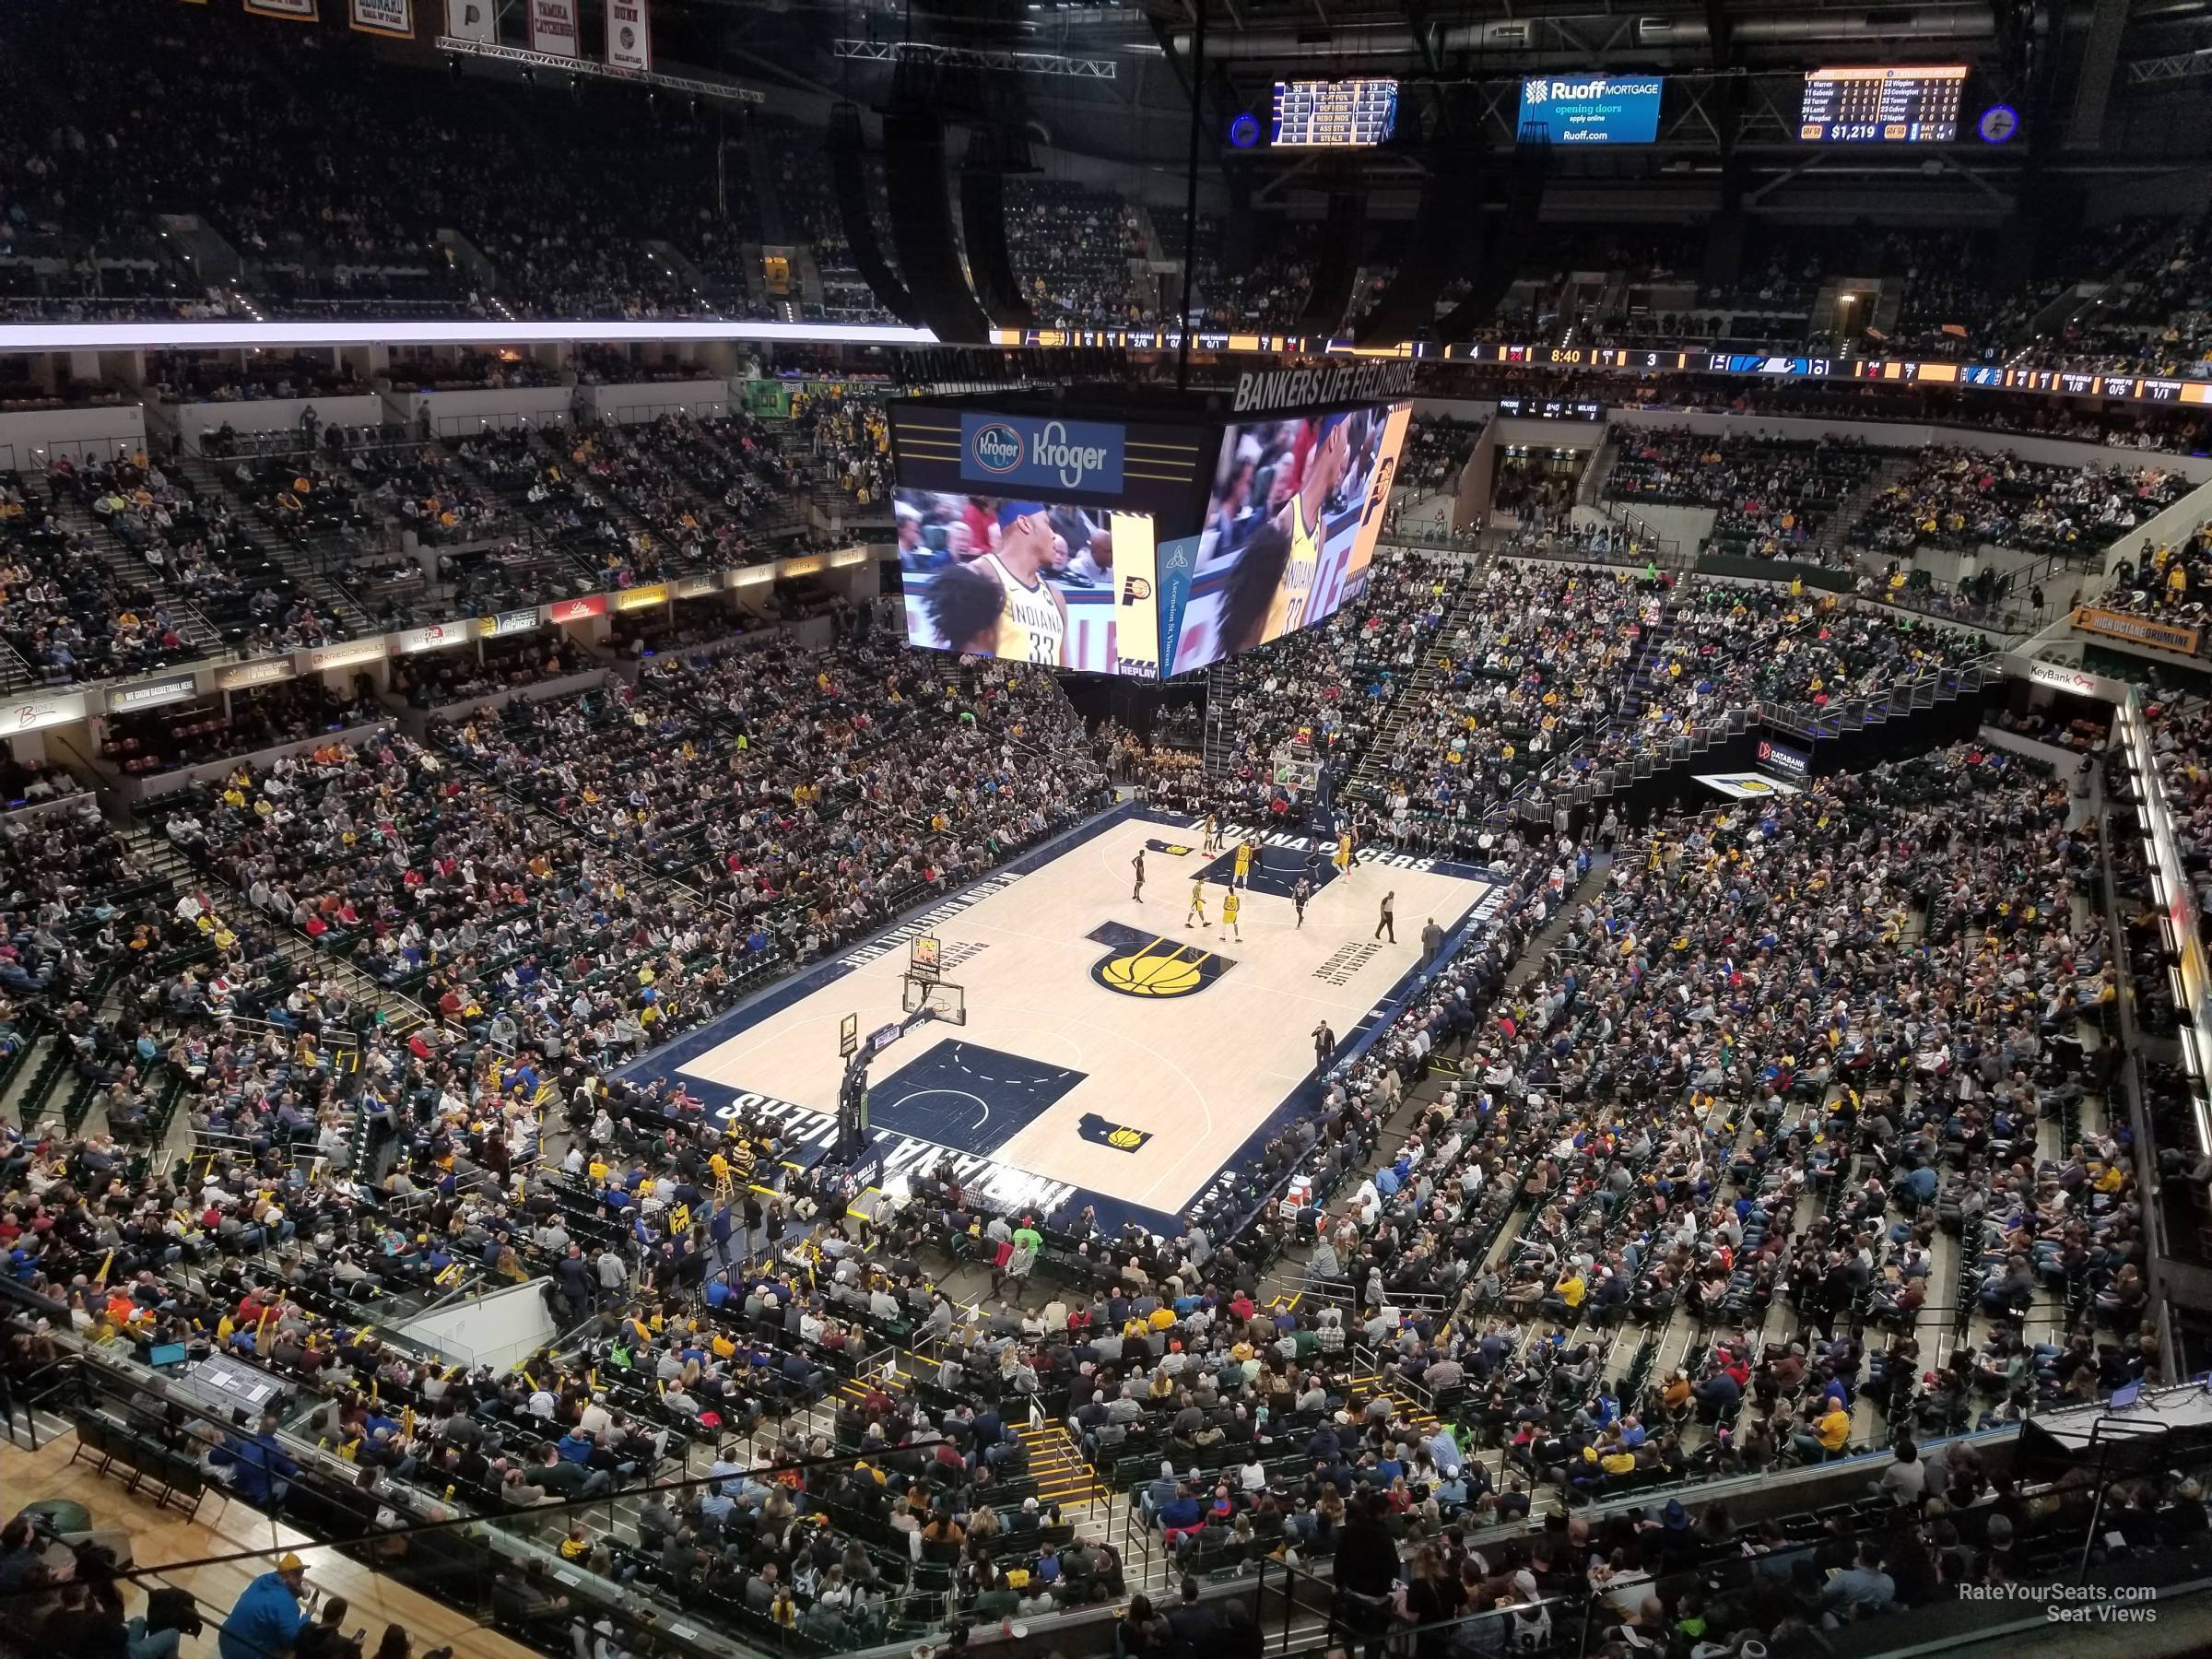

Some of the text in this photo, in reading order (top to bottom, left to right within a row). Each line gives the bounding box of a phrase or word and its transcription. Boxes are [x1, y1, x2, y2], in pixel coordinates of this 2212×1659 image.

[538, 2, 568, 20] TAMIKA
[615, 6, 638, 22] DUNN
[1551, 81, 1658, 99] Ruoff MORTGAGE
[1556, 103, 1622, 115] opening doors
[1570, 115, 1586, 124] apply
[1563, 130, 1607, 140] Ruoff.com
[1831, 124, 1875, 140] $1,219
[1135, 339, 1147, 347] 2/6
[1206, 340, 1219, 348] 0/1
[1469, 346, 1479, 359] 4
[1511, 352, 1522, 360] 24
[1551, 349, 1580, 362] 8:40
[1605, 356, 1609, 365] 1
[1647, 354, 1656, 366] 3
[1869, 369, 1877, 377] 2
[1906, 370, 1913, 379] 7
[1234, 361, 1418, 411] BANKERS LIFE FIELDHOUSE
[2018, 377, 2024, 386] 4
[2041, 379, 2046, 389] 1
[2068, 382, 2083, 392] 1/8
[2109, 385, 2125, 395] 0/5
[2154, 388, 2169, 399] 1/1
[980, 431, 1019, 465] Kroger
[1032, 421, 1107, 488] Kroger
[1340, 577, 1365, 604] REPLAY
[571, 601, 590, 614] Lilly
[1169, 579, 1180, 622] Ascension
[502, 617, 536, 630] @Pacers
[1010, 603, 1064, 634] INDIANA
[424, 629, 439, 637] the
[2094, 616, 2190, 647] HIGH OCTANE DRUMLINE
[427, 636, 444, 645] fan
[1030, 632, 1054, 664] 33
[1164, 634, 1173, 667] Vincent
[1120, 665, 1156, 678] REPLAY
[2030, 665, 2071, 684] KeyBank
[125, 680, 194, 700] WE GROW BASKETBALL HERE
[1297, 733, 1309, 743] 24
[1771, 750, 1806, 769] DATABANK
[956, 877, 1002, 905] GROW
[875, 902, 965, 949] BASKETBALL
[837, 945, 886, 968] HERE
[1312, 941, 1363, 979] FIELDHOUSE
[1326, 943, 1382, 986] BANKERS LIFE
[857, 1159, 877, 1181] BELLE
[861, 1170, 877, 1187] TIRE
